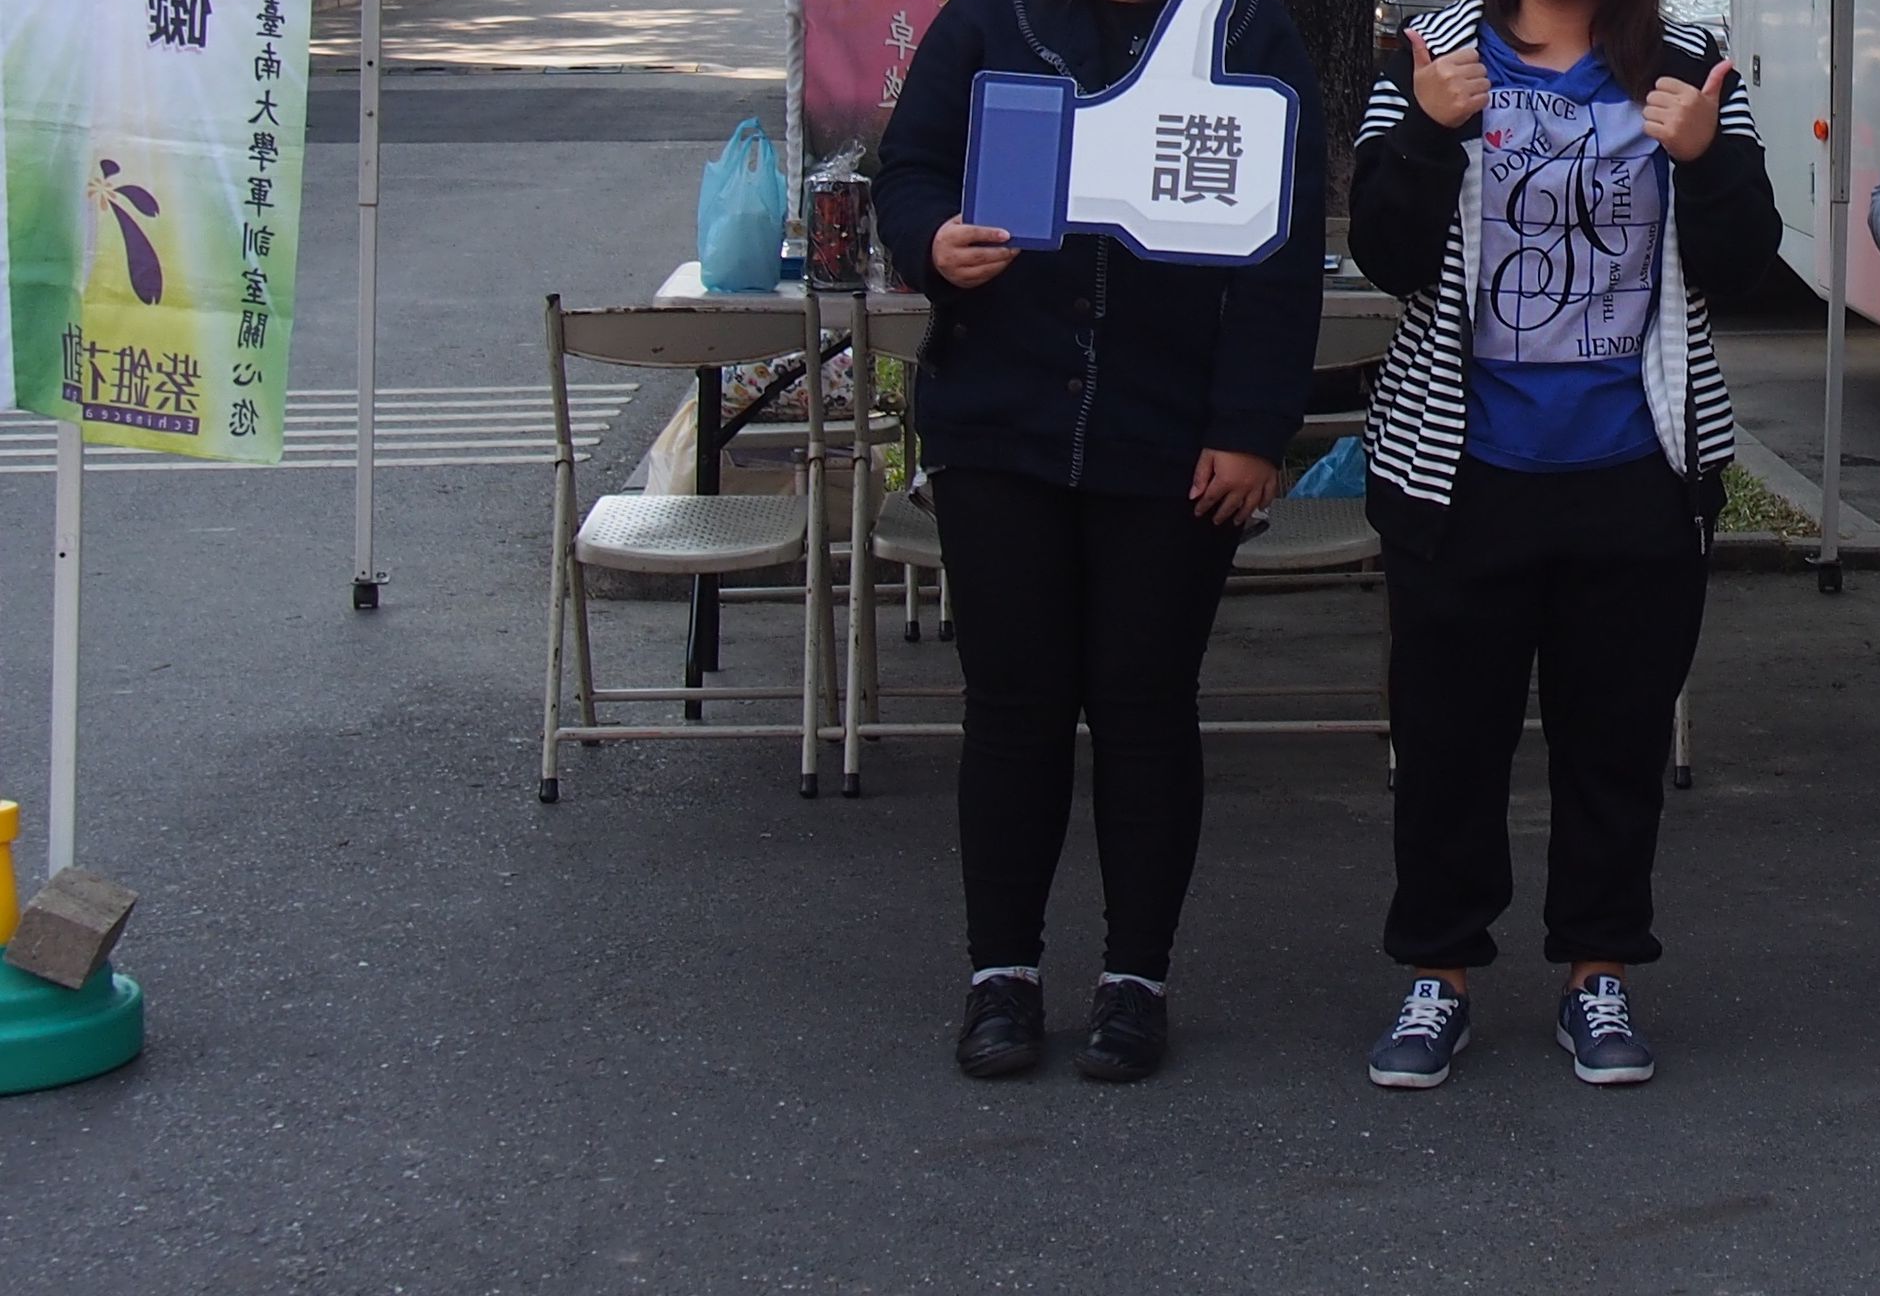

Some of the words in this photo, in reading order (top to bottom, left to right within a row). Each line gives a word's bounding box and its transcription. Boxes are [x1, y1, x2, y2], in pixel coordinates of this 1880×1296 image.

[1486, 89, 1577, 121] ISTANCE
[1151, 114, 1244, 207] 讚
[1490, 131, 1553, 184] DONE
[1612, 159, 1632, 222] THAN
[1603, 294, 1615, 323] THE
